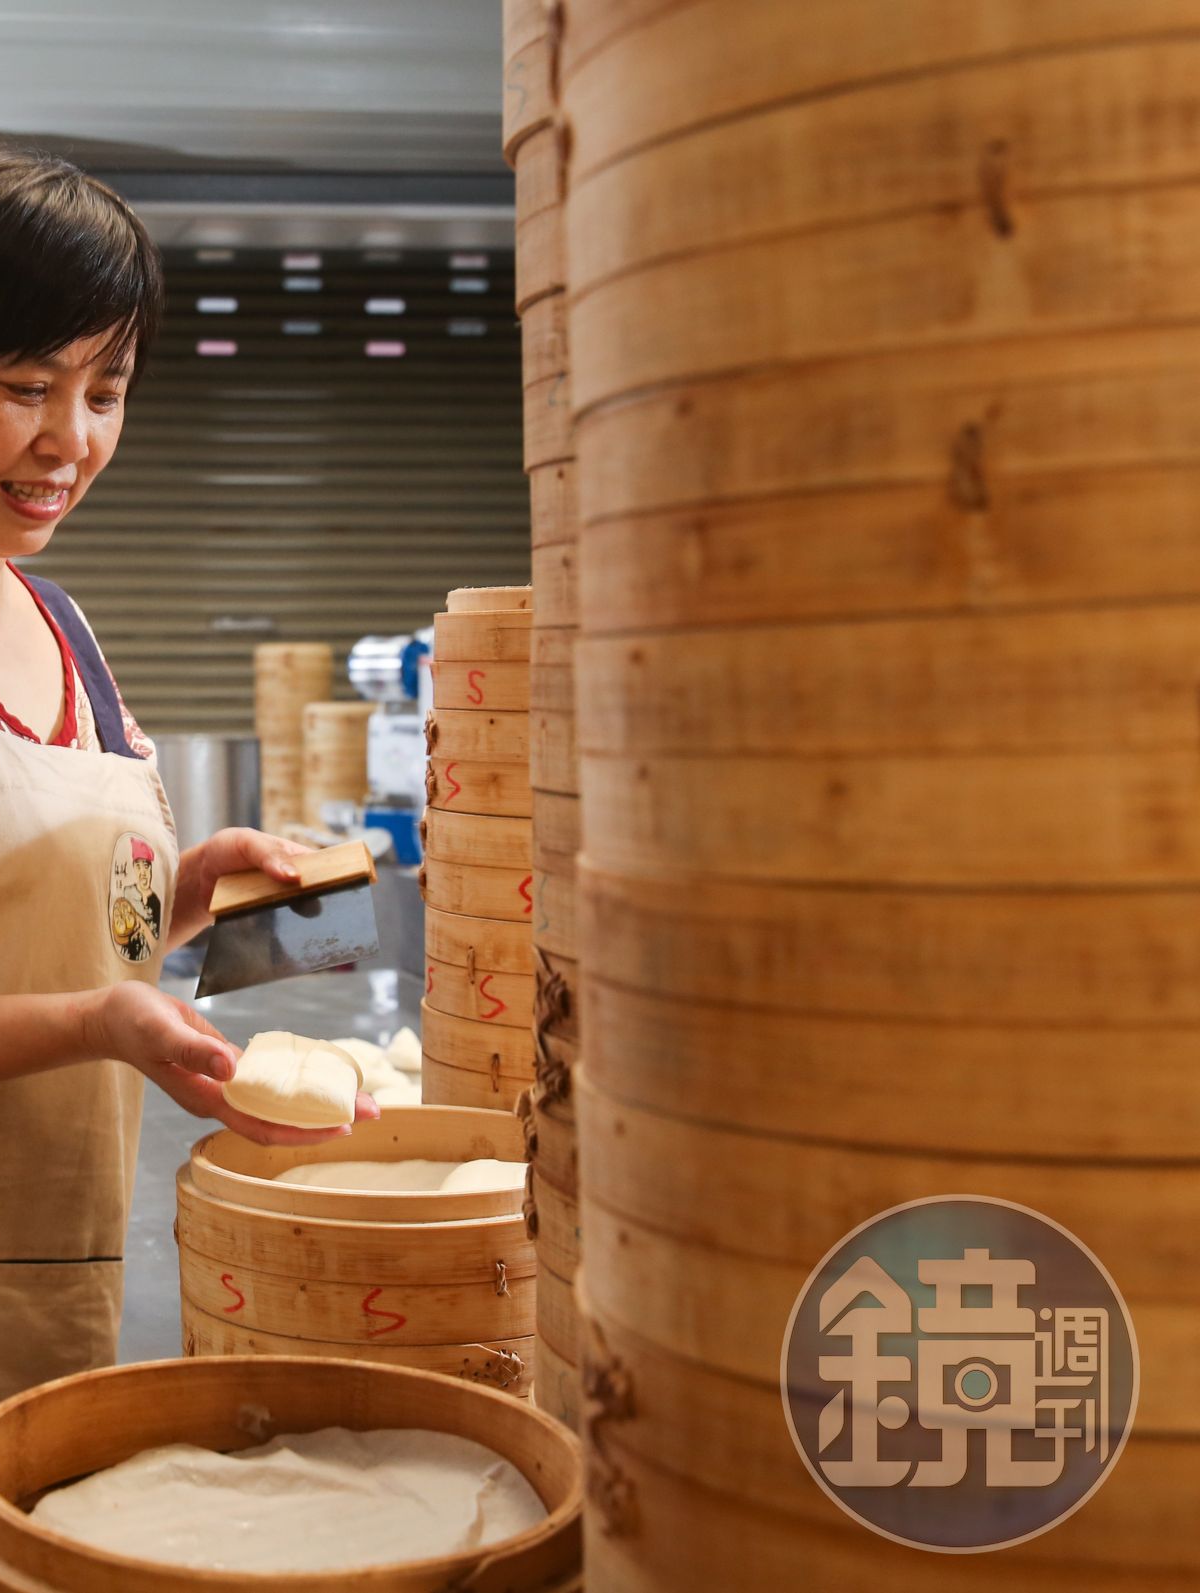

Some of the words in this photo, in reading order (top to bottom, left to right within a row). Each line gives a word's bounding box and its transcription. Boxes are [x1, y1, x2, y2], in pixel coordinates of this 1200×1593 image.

[467, 670, 485, 704] S
[444, 762, 461, 804] S
[480, 975, 506, 1019] S
[221, 1274, 245, 1313] S
[362, 1287, 407, 1338] S
